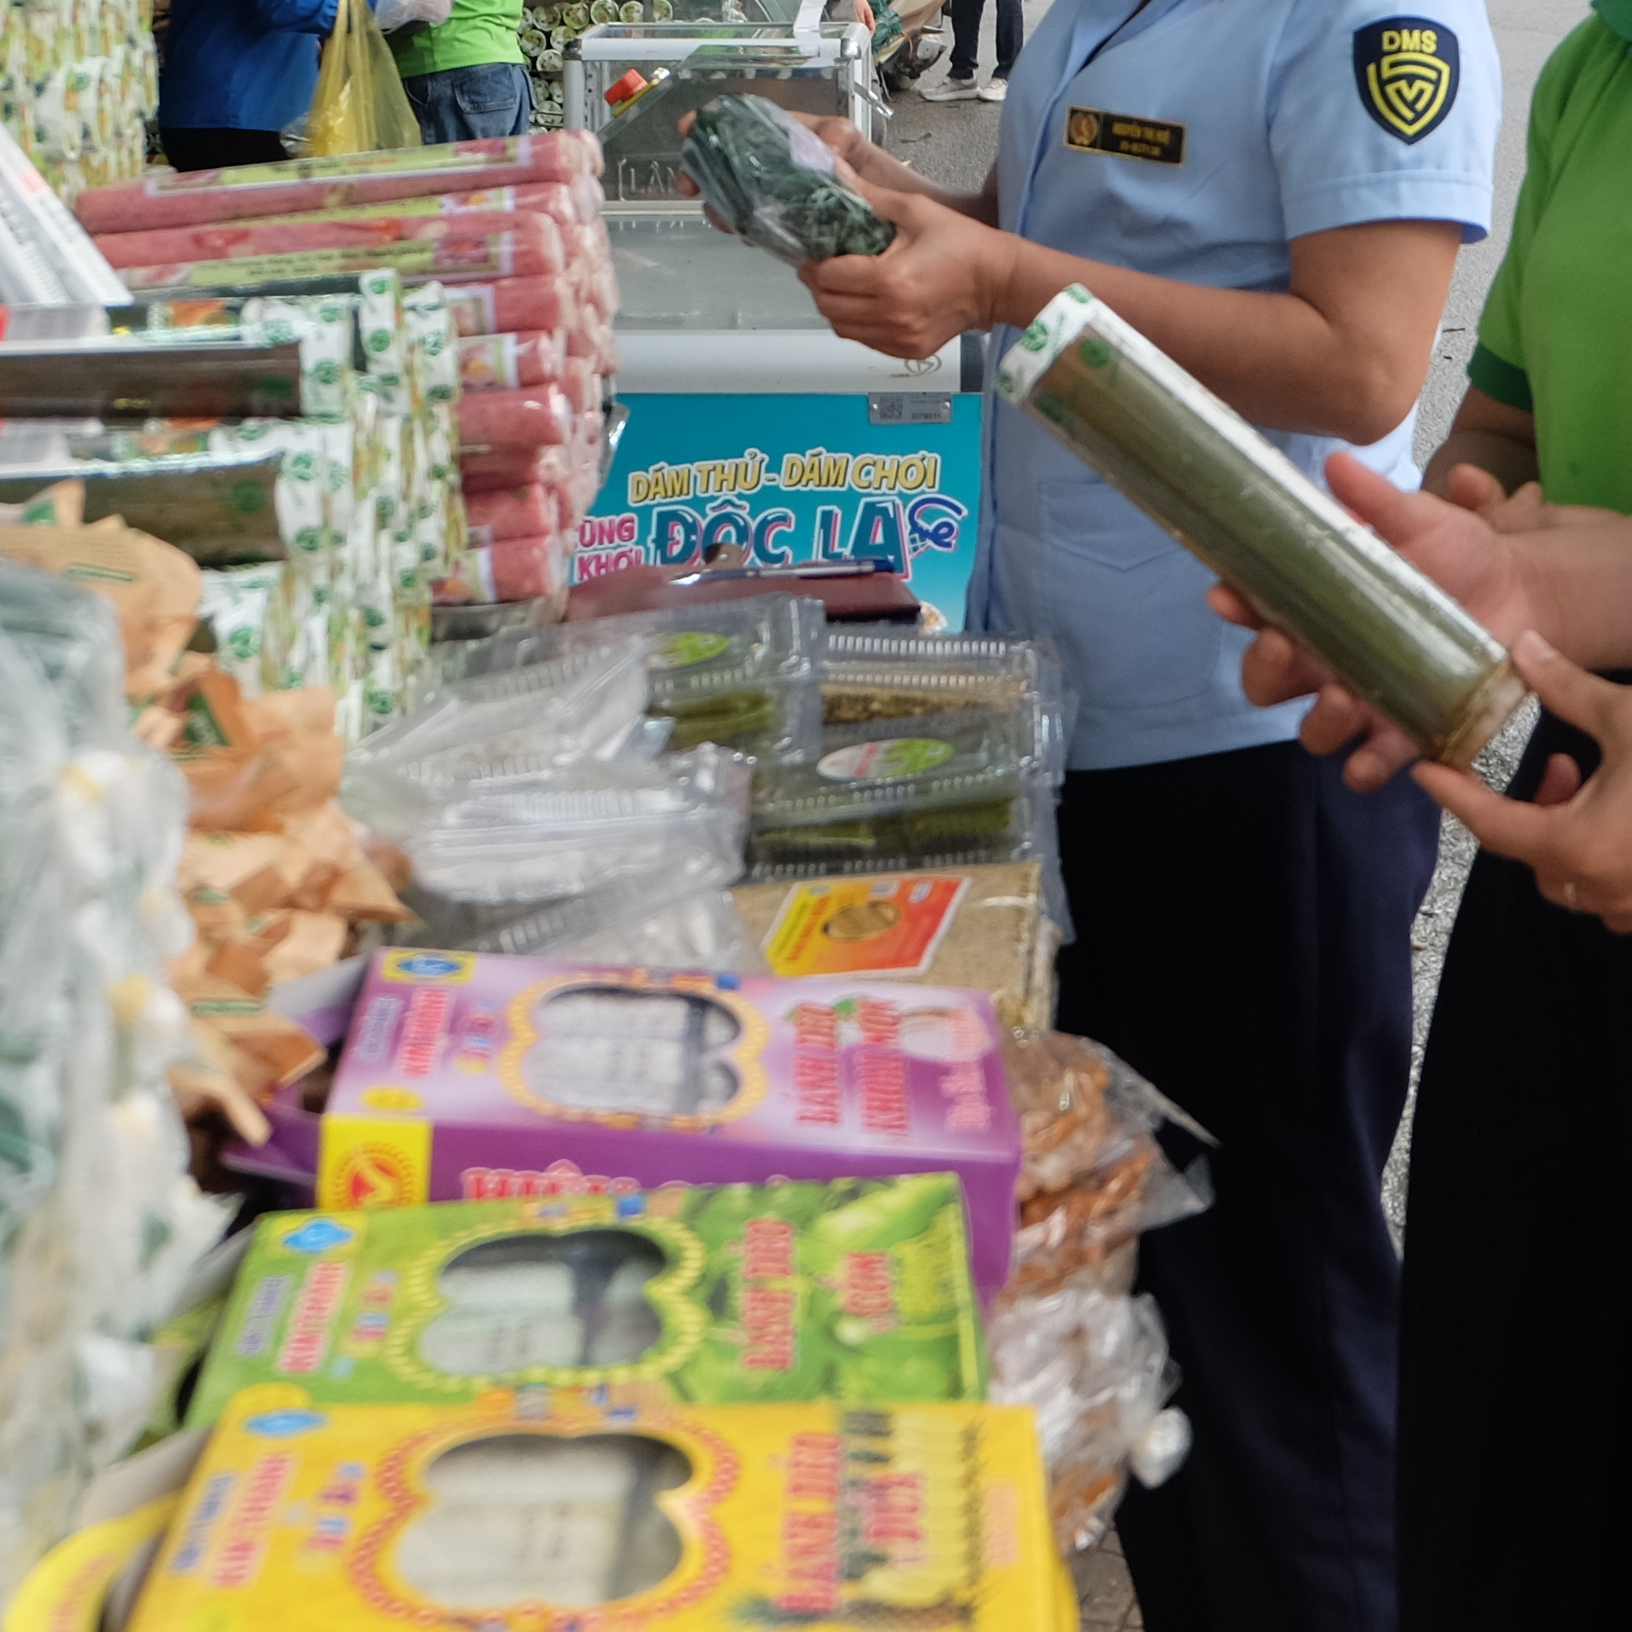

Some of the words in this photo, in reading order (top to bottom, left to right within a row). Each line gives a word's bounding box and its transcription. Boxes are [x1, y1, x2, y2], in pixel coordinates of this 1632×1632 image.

[1381, 29, 1438, 55] DMS
[630, 461, 692, 505] DÁM
[696, 448, 767, 495] THỬ
[781, 448, 849, 490] DÁM
[852, 451, 941, 493] CHƠI
[576, 513, 638, 550] ÙNG
